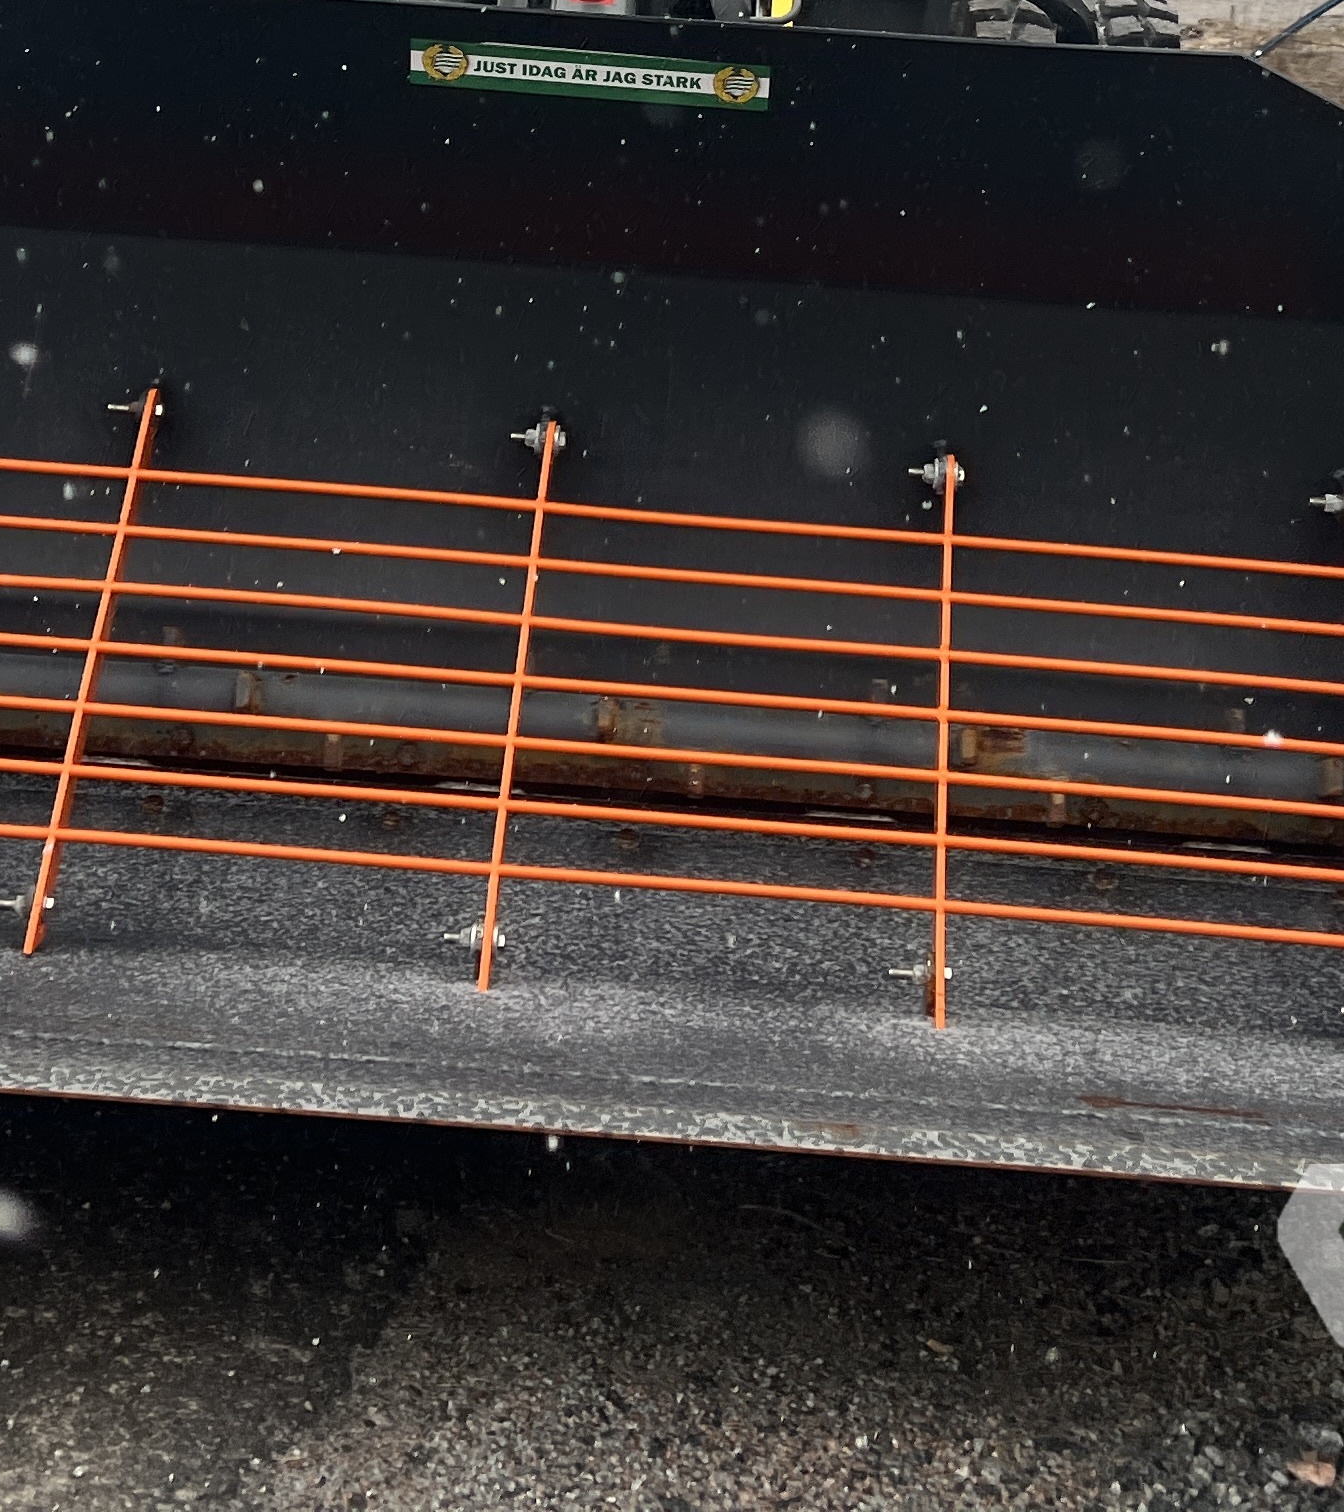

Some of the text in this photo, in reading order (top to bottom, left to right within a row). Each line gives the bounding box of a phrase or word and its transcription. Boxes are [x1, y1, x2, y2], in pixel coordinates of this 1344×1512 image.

[474, 60, 702, 90] JUST IDAG ÄR JAG STARK
